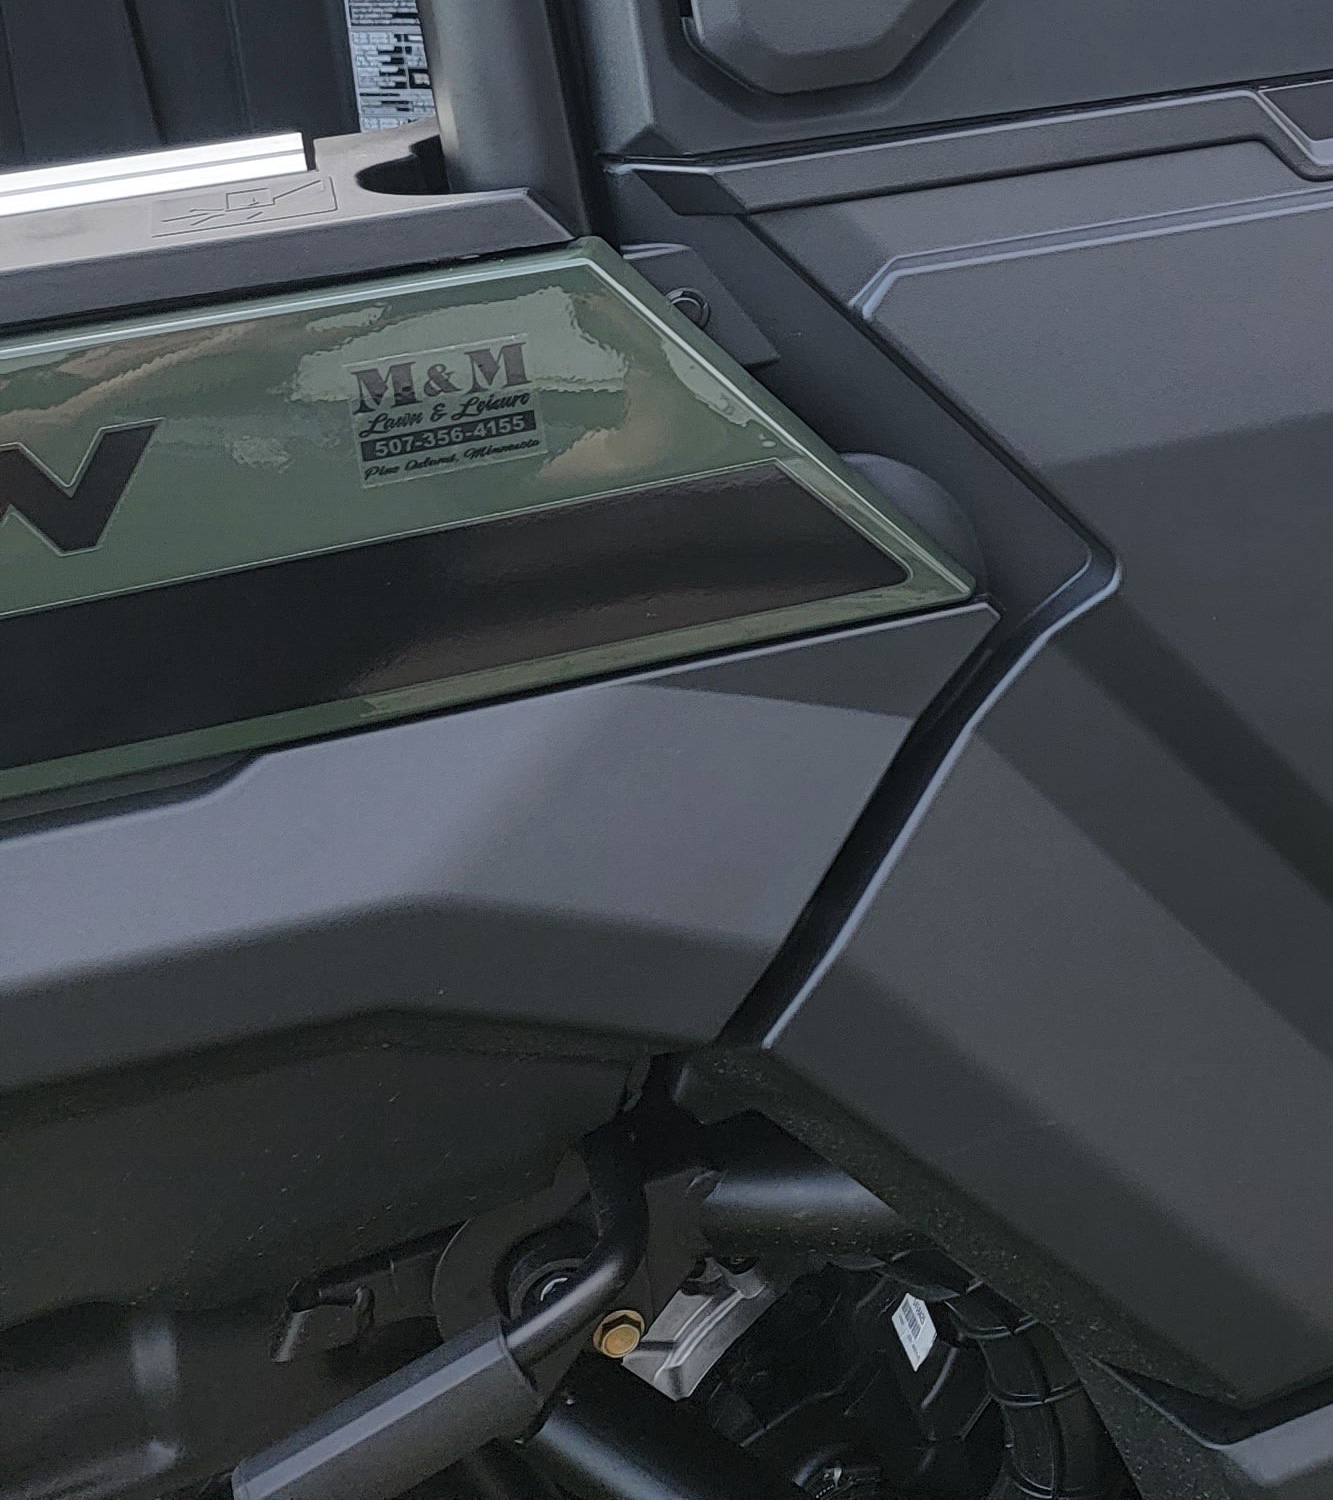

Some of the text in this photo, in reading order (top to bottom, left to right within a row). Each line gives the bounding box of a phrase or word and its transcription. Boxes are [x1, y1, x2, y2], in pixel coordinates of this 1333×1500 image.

[359, 391, 531, 438] Lawn & Leisure
[374, 415, 526, 457] 507-356-4155
